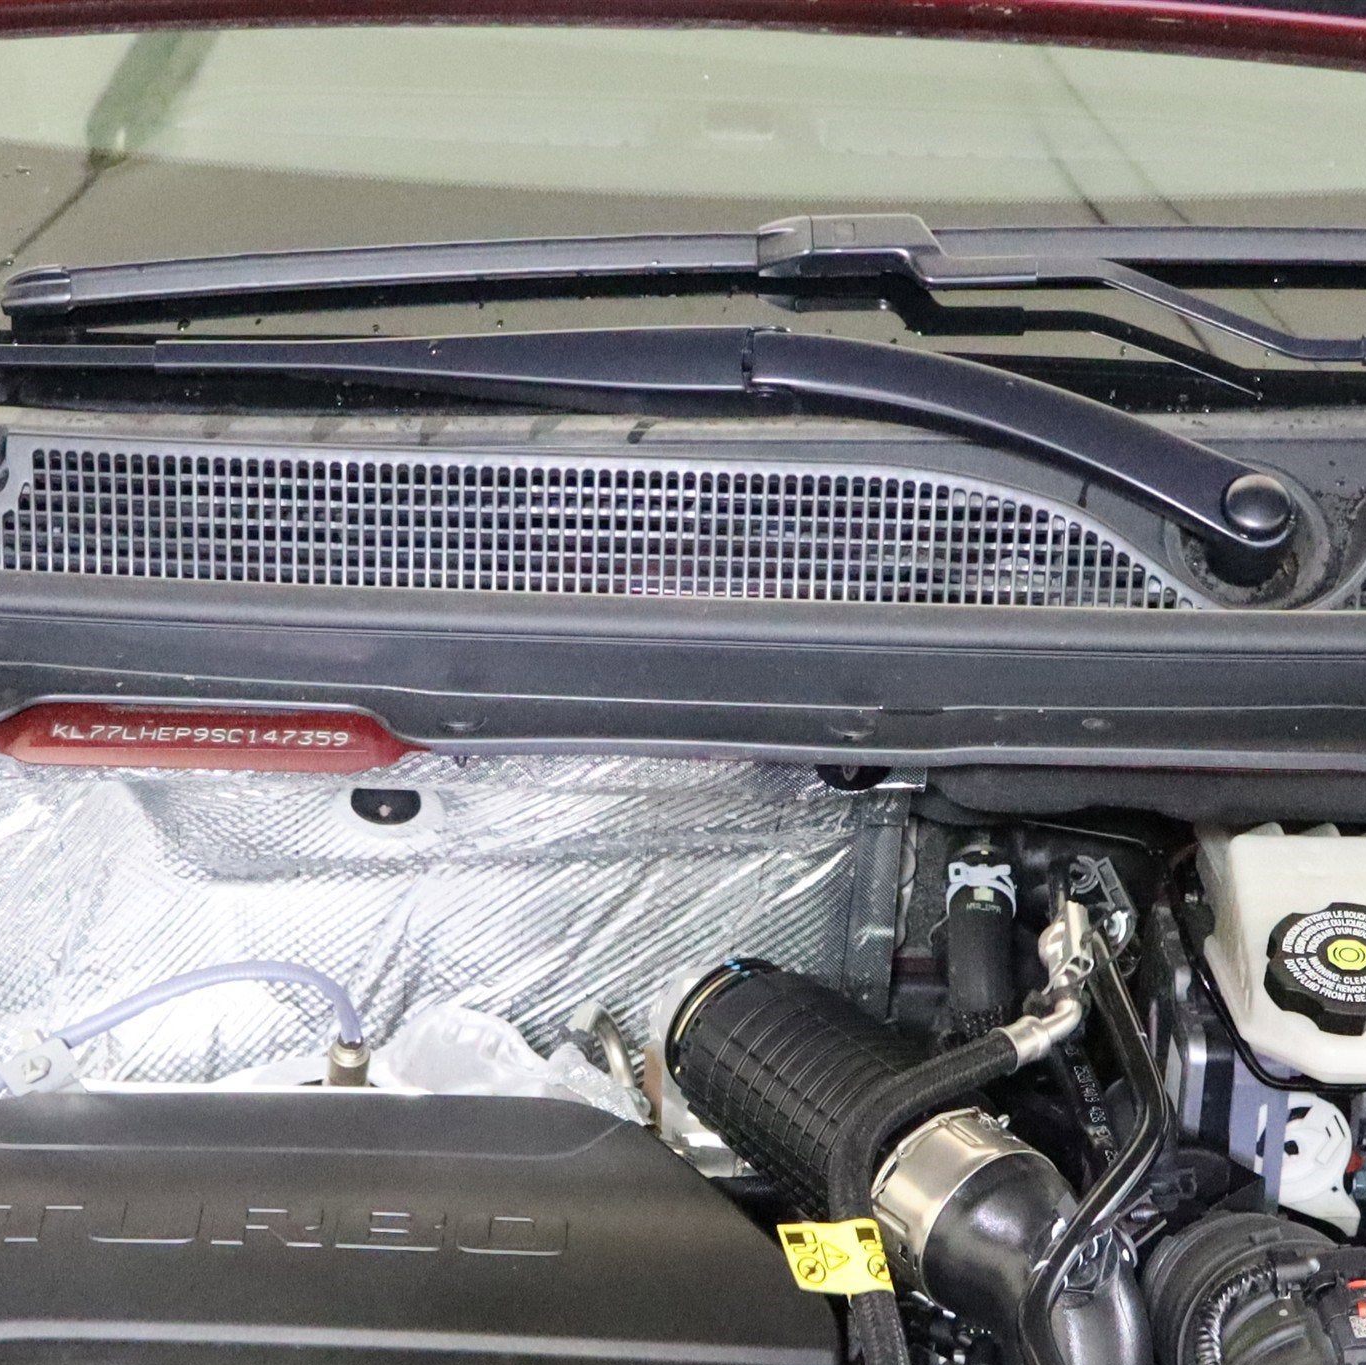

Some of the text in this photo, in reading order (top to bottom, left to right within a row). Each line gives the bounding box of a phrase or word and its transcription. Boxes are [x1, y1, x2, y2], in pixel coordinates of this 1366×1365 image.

[51, 723, 349, 746] KL77LHEP9SC147359
[1296, 974, 1320, 991] FLUID
[1319, 987, 1345, 1001] FROM
